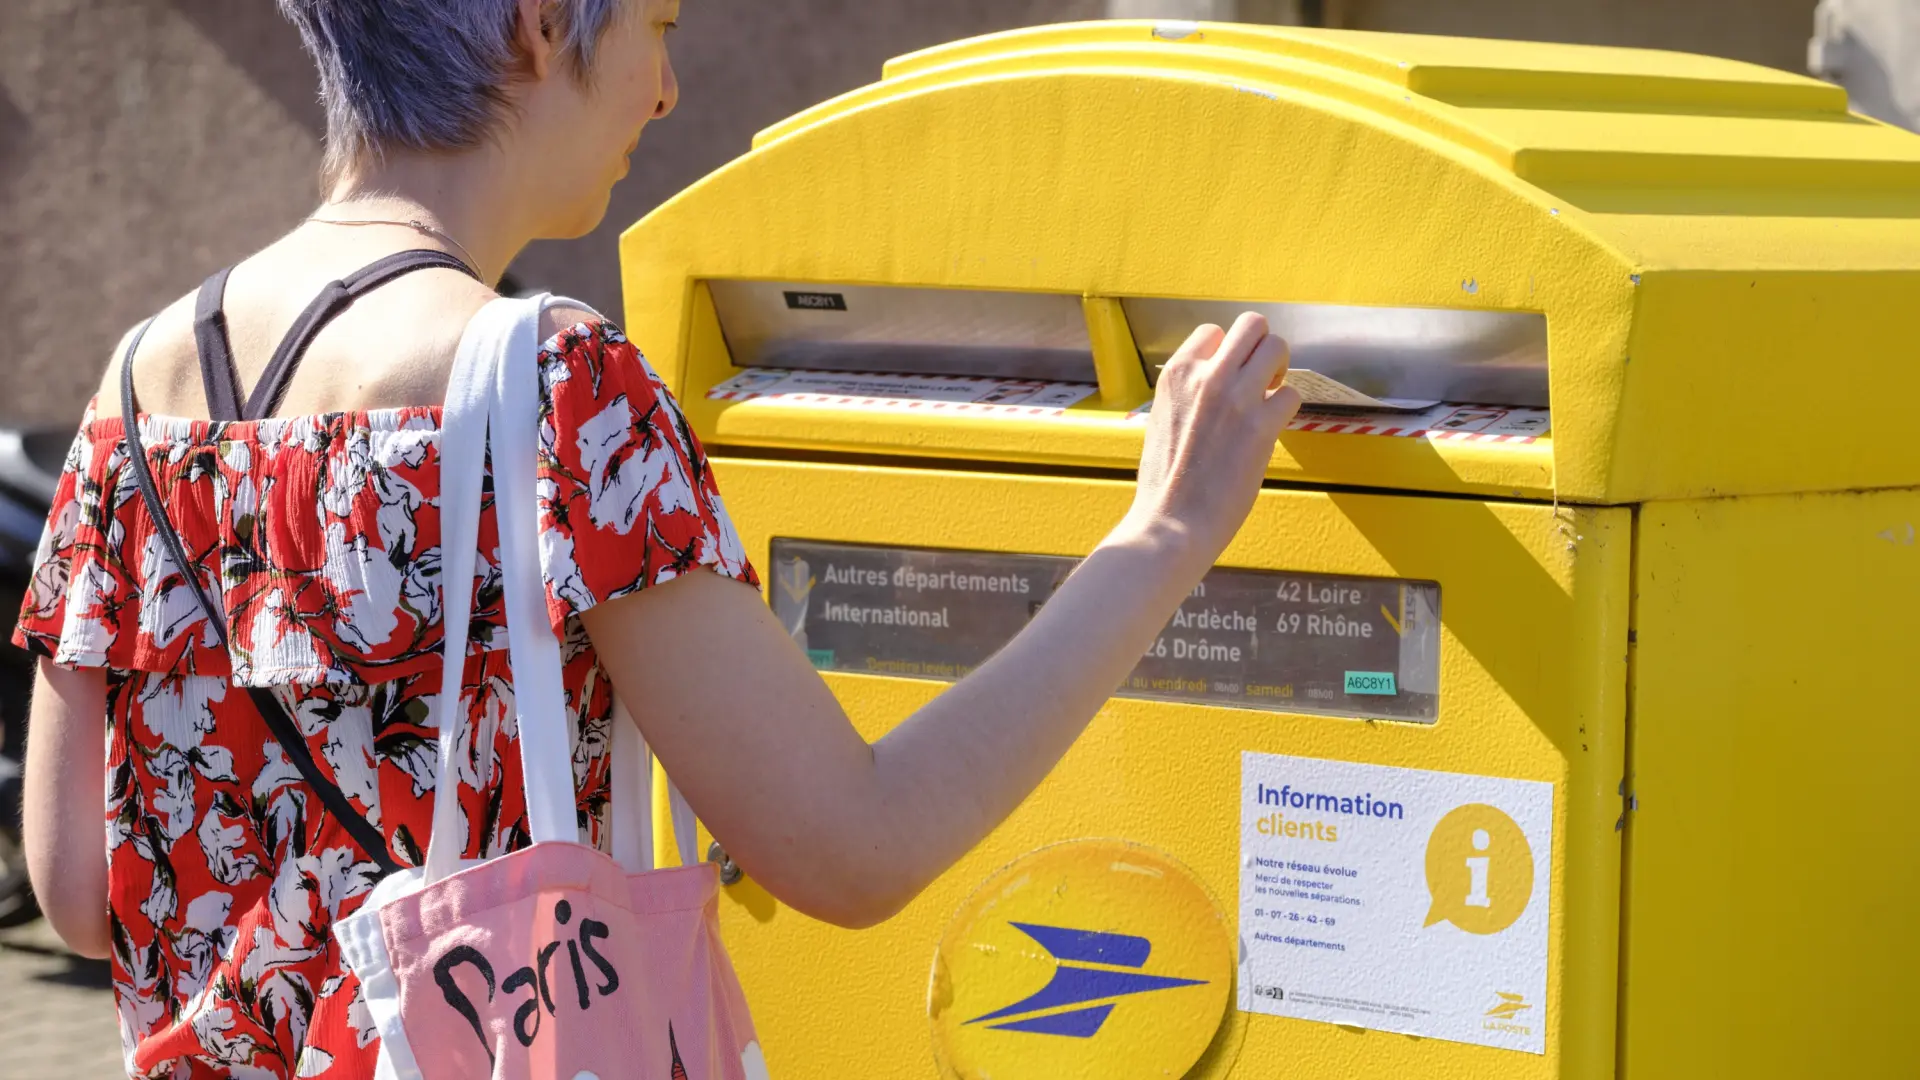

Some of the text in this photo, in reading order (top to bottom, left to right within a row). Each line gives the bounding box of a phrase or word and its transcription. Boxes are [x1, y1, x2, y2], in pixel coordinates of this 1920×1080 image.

[824, 564, 1030, 594] Autres départements
[1276, 582, 1361, 605] 42 Loire
[825, 601, 949, 628] International
[1172, 605, 1258, 632] Ardèche
[1276, 612, 1373, 638] 69 Rhône
[1173, 638, 1241, 662] Drôme
[1152, 677, 1207, 693] vendredi
[1246, 682, 1294, 698] samedi
[1347, 676, 1392, 690] A6C8Y1
[1258, 783, 1404, 820] Information
[1256, 812, 1338, 842] clients
[1256, 857, 1358, 878] Notre réseau évolue
[1255, 873, 1334, 891] Merci de respecter
[1255, 885, 1267, 894] les
[1268, 888, 1309, 899] nouvelles
[1310, 891, 1361, 906] séparations
[1254, 908, 1264, 917] 01
[1270, 910, 1281, 919] 07
[1288, 912, 1300, 922] 26
[1306, 915, 1318, 924] 42
[1254, 932, 1346, 952] Autres départements
[433, 899, 620, 1076] Paris
[1498, 1022, 1532, 1037] POSTE
